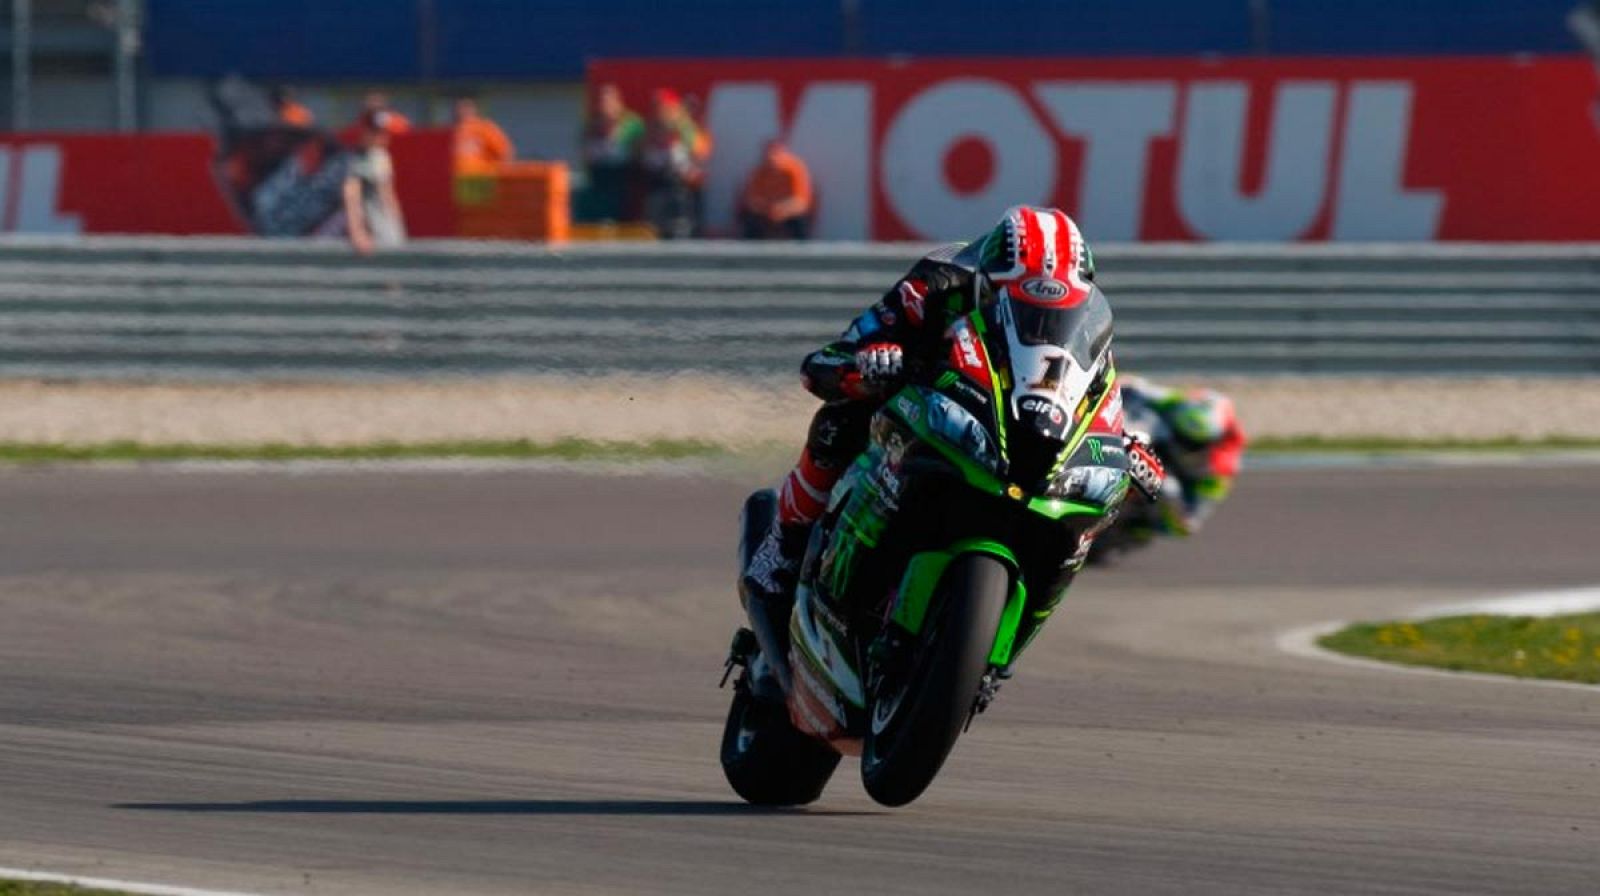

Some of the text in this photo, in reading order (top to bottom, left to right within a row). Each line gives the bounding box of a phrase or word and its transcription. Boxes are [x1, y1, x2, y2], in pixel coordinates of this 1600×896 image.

[706, 78, 1446, 240] MOTUL
[1025, 281, 1062, 296] Arai
[1028, 355, 1066, 391] 1
